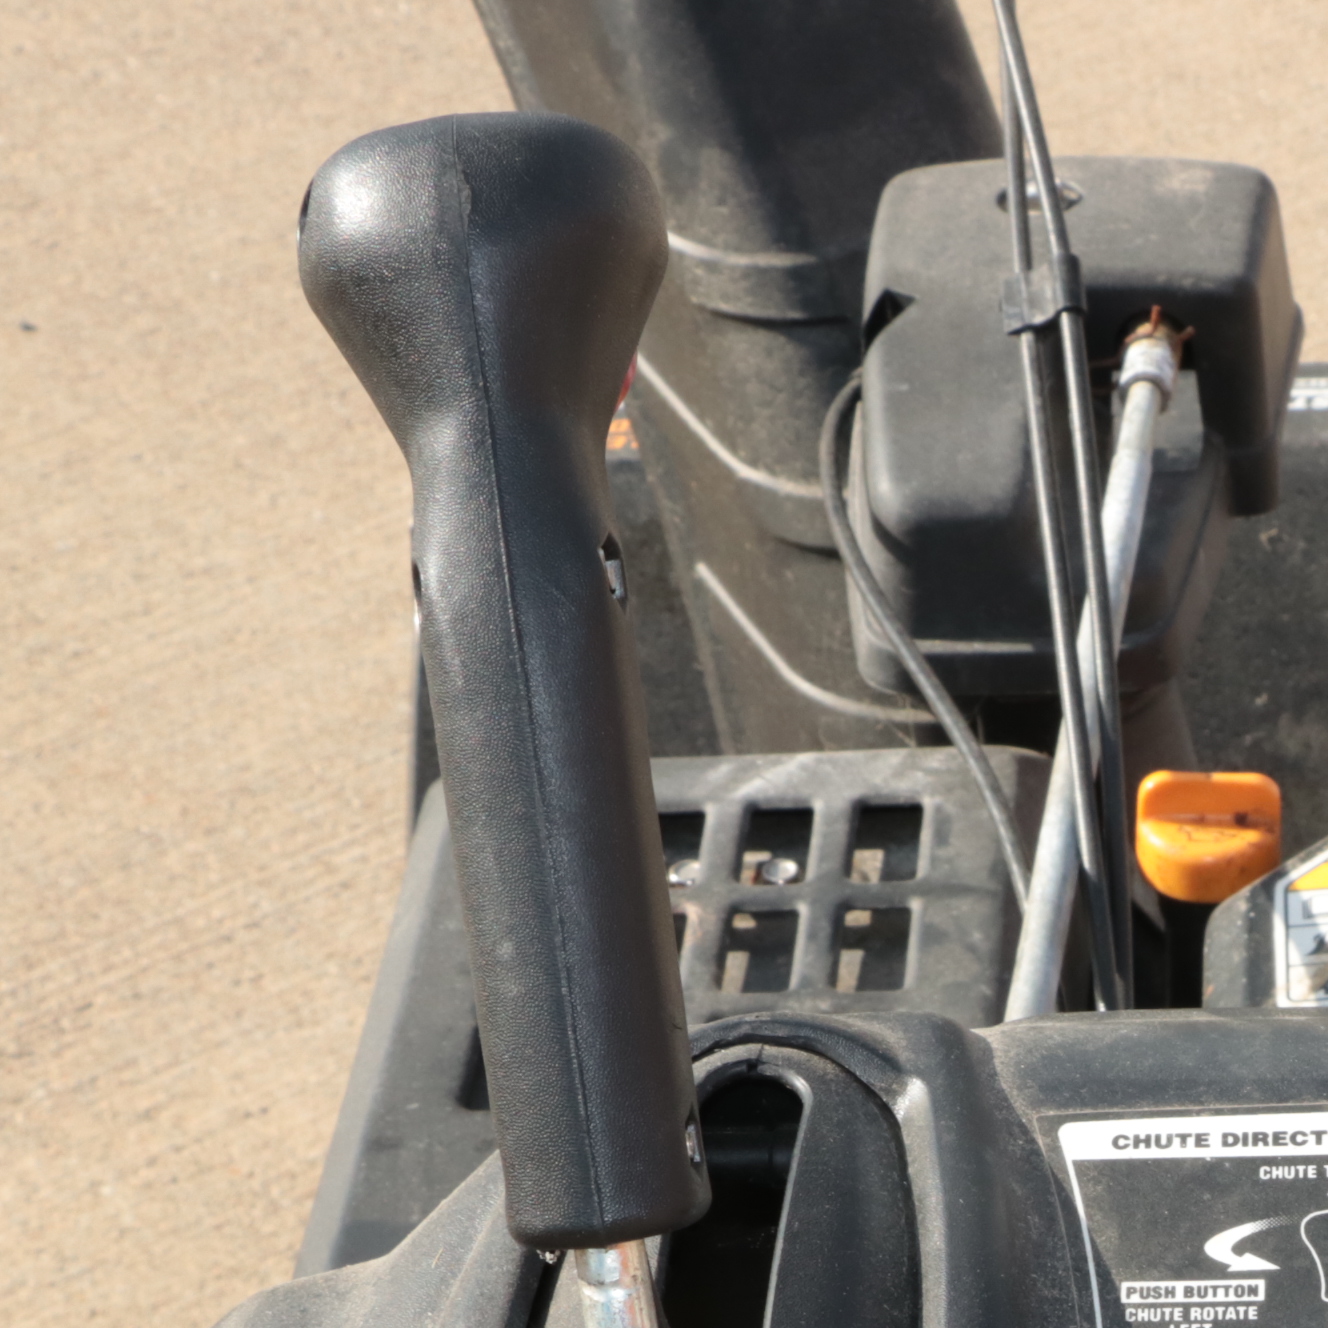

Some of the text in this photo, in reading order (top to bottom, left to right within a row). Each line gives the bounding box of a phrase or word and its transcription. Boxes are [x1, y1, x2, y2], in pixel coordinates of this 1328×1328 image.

[1112, 1133, 1210, 1150] CHUTE
[1259, 1165, 1316, 1179] CHUTE
[1126, 1285, 1258, 1299] PUSH BUTTON
[1126, 1306, 1257, 1322] CHUTE ROTATE
